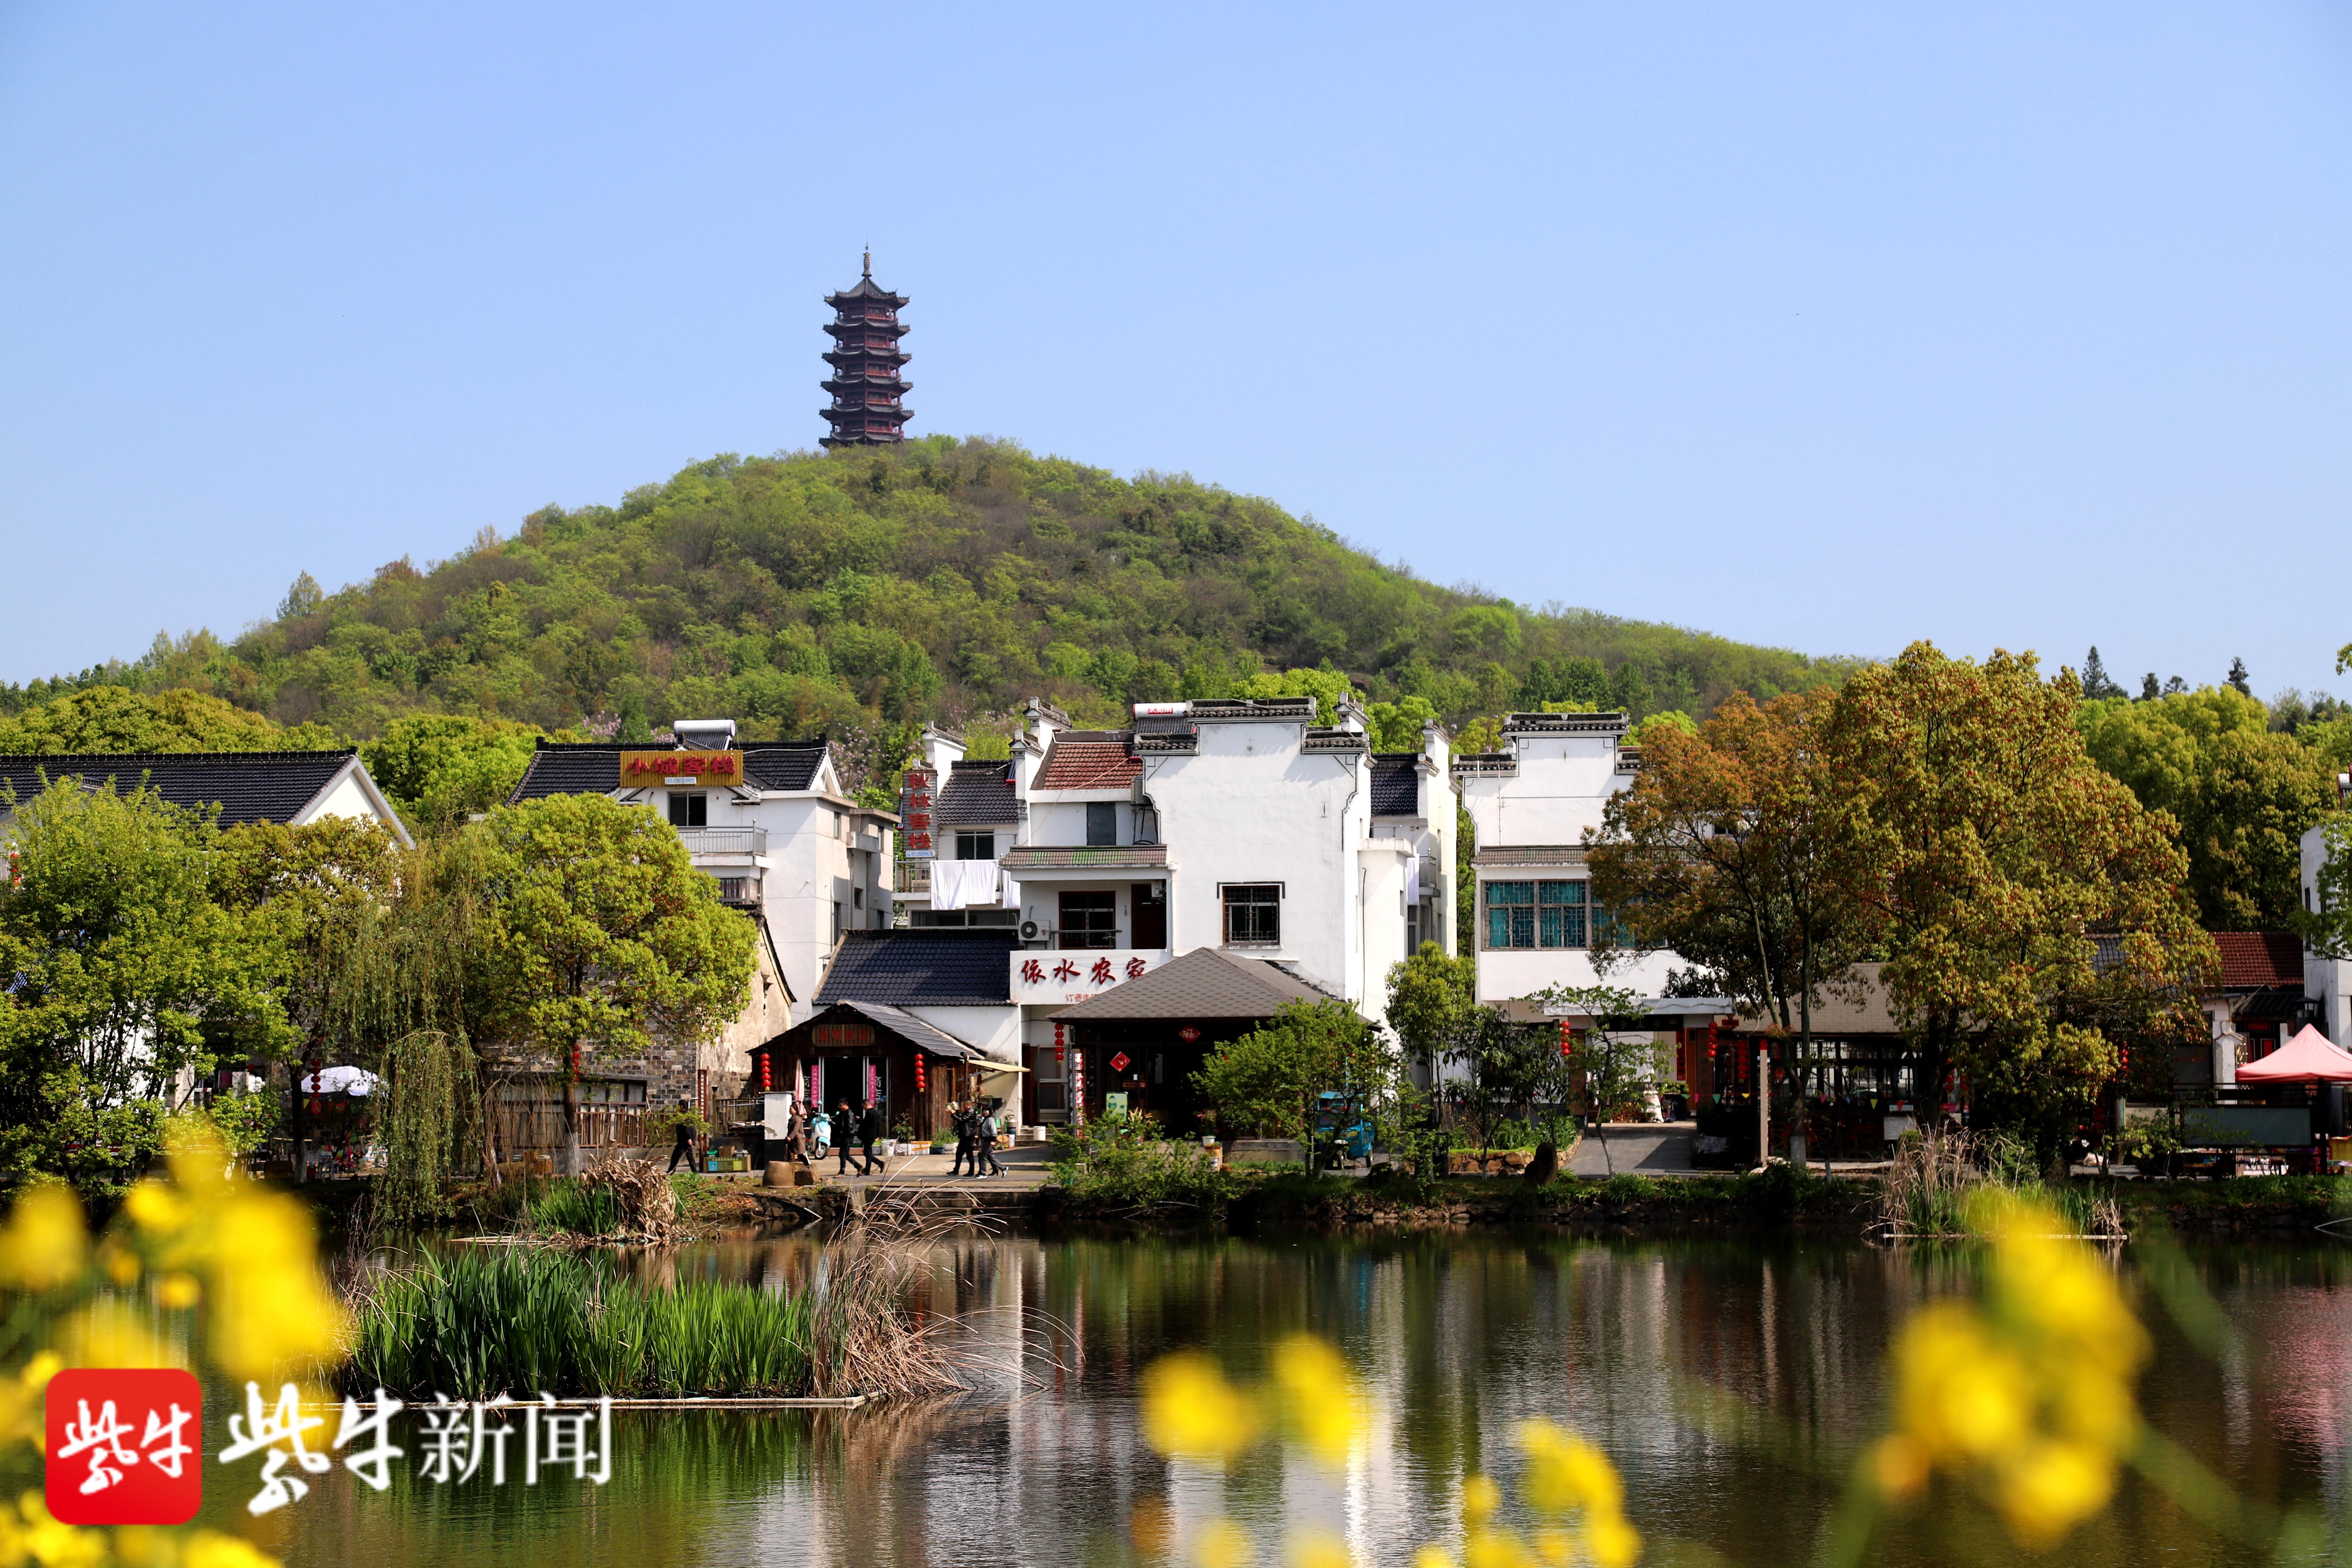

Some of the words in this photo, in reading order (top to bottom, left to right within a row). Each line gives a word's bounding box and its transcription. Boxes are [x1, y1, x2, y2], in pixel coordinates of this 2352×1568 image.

[626, 755, 735, 775] 小城客栈
[908, 773, 933, 849] 秋林客栈
[1021, 957, 1147, 985] 依水农家
